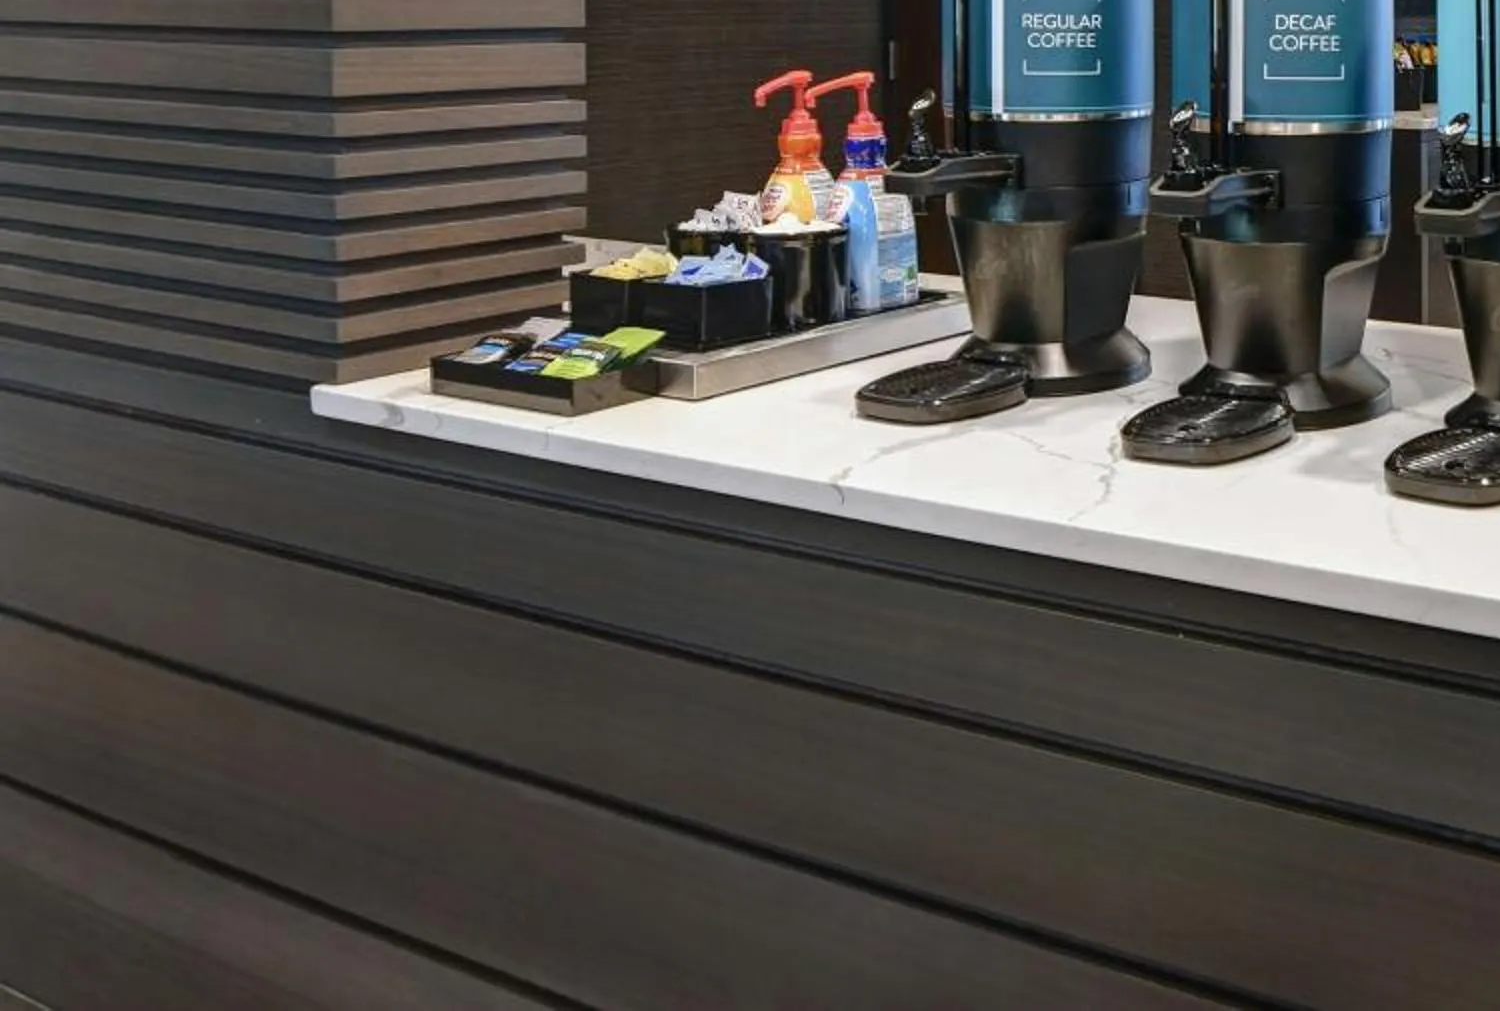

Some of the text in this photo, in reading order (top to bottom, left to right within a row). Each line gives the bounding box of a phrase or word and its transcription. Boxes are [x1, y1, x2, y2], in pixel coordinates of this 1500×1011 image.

[1021, 13, 1102, 29] REGULAR
[1275, 14, 1337, 30] DECAF
[1027, 32, 1097, 48] COFFEE
[1269, 34, 1342, 52] COFFEE
